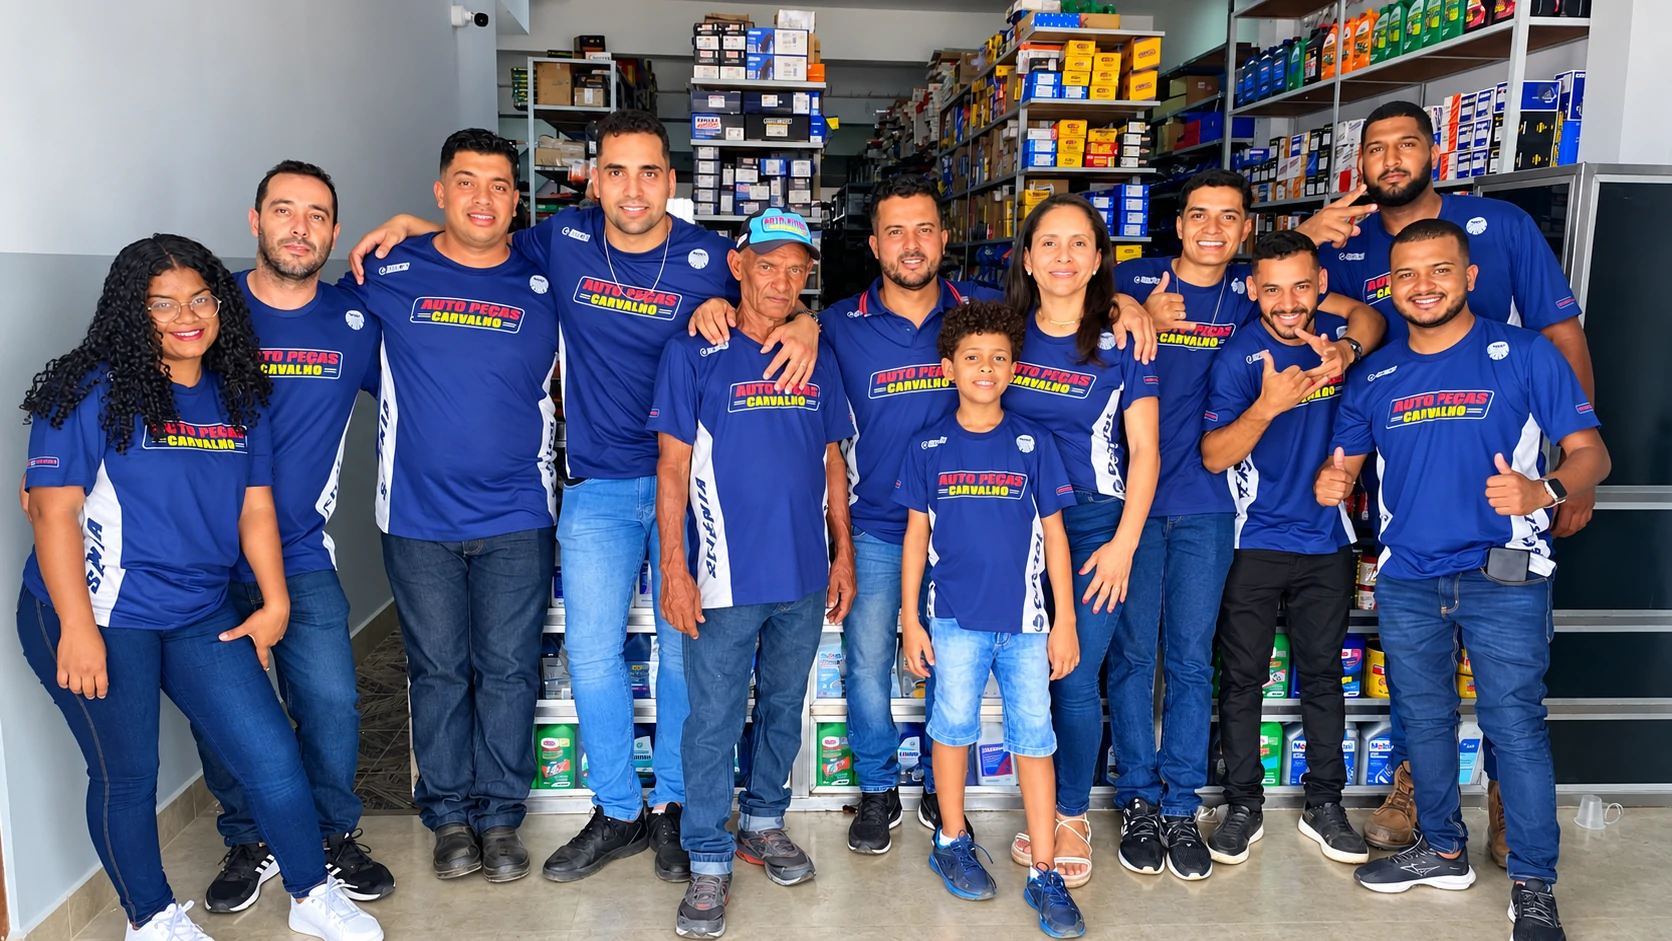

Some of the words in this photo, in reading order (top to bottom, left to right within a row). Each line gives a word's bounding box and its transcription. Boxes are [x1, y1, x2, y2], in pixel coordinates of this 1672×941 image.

[582, 278, 623, 297] AUTO
[421, 299, 466, 312] AUTO
[590, 293, 657, 315] CARVALHO
[431, 311, 502, 328] CARVALHO
[1160, 333, 1218, 347] CARVALHO
[876, 367, 916, 384] AUTO
[735, 383, 774, 397] AUTO
[887, 378, 950, 393] CARVALHO
[1010, 375, 1070, 393] ARVALHO
[746, 396, 806, 407] CARVALHO
[1393, 394, 1434, 413] AUTO
[167, 435, 235, 449] CARVALHO
[939, 474, 976, 486] AUTO
[948, 485, 1009, 496] CARVALHO
